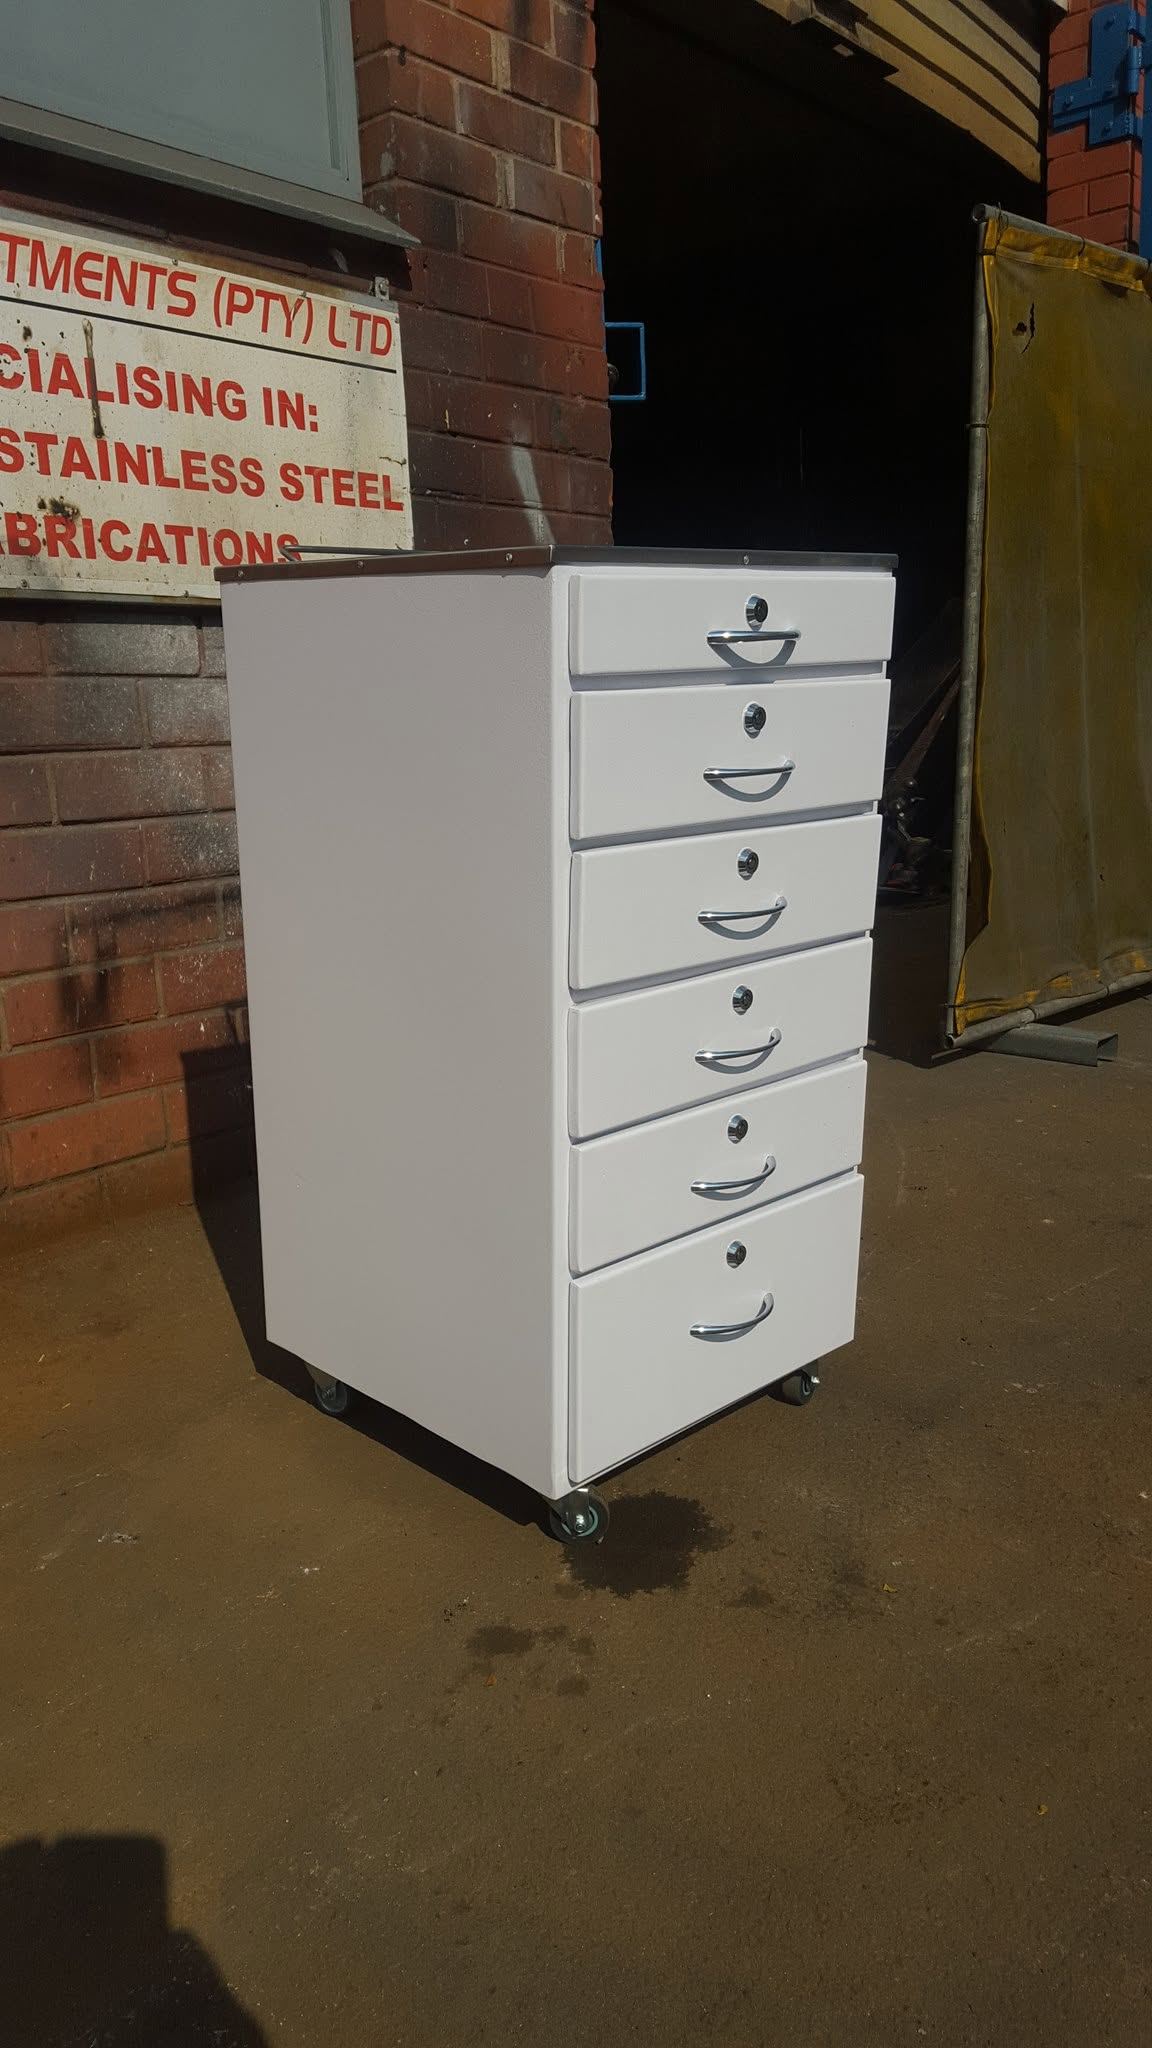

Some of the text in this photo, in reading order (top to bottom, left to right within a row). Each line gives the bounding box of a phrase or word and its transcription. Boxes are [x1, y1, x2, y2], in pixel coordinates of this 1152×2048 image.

[0, 231, 393, 357] TMENTS (PTY) LTD
[0, 342, 319, 432] CIALISING IN:
[0, 427, 404, 512] STAINLESS STEEL
[0, 511, 303, 567] BRICATIONS
